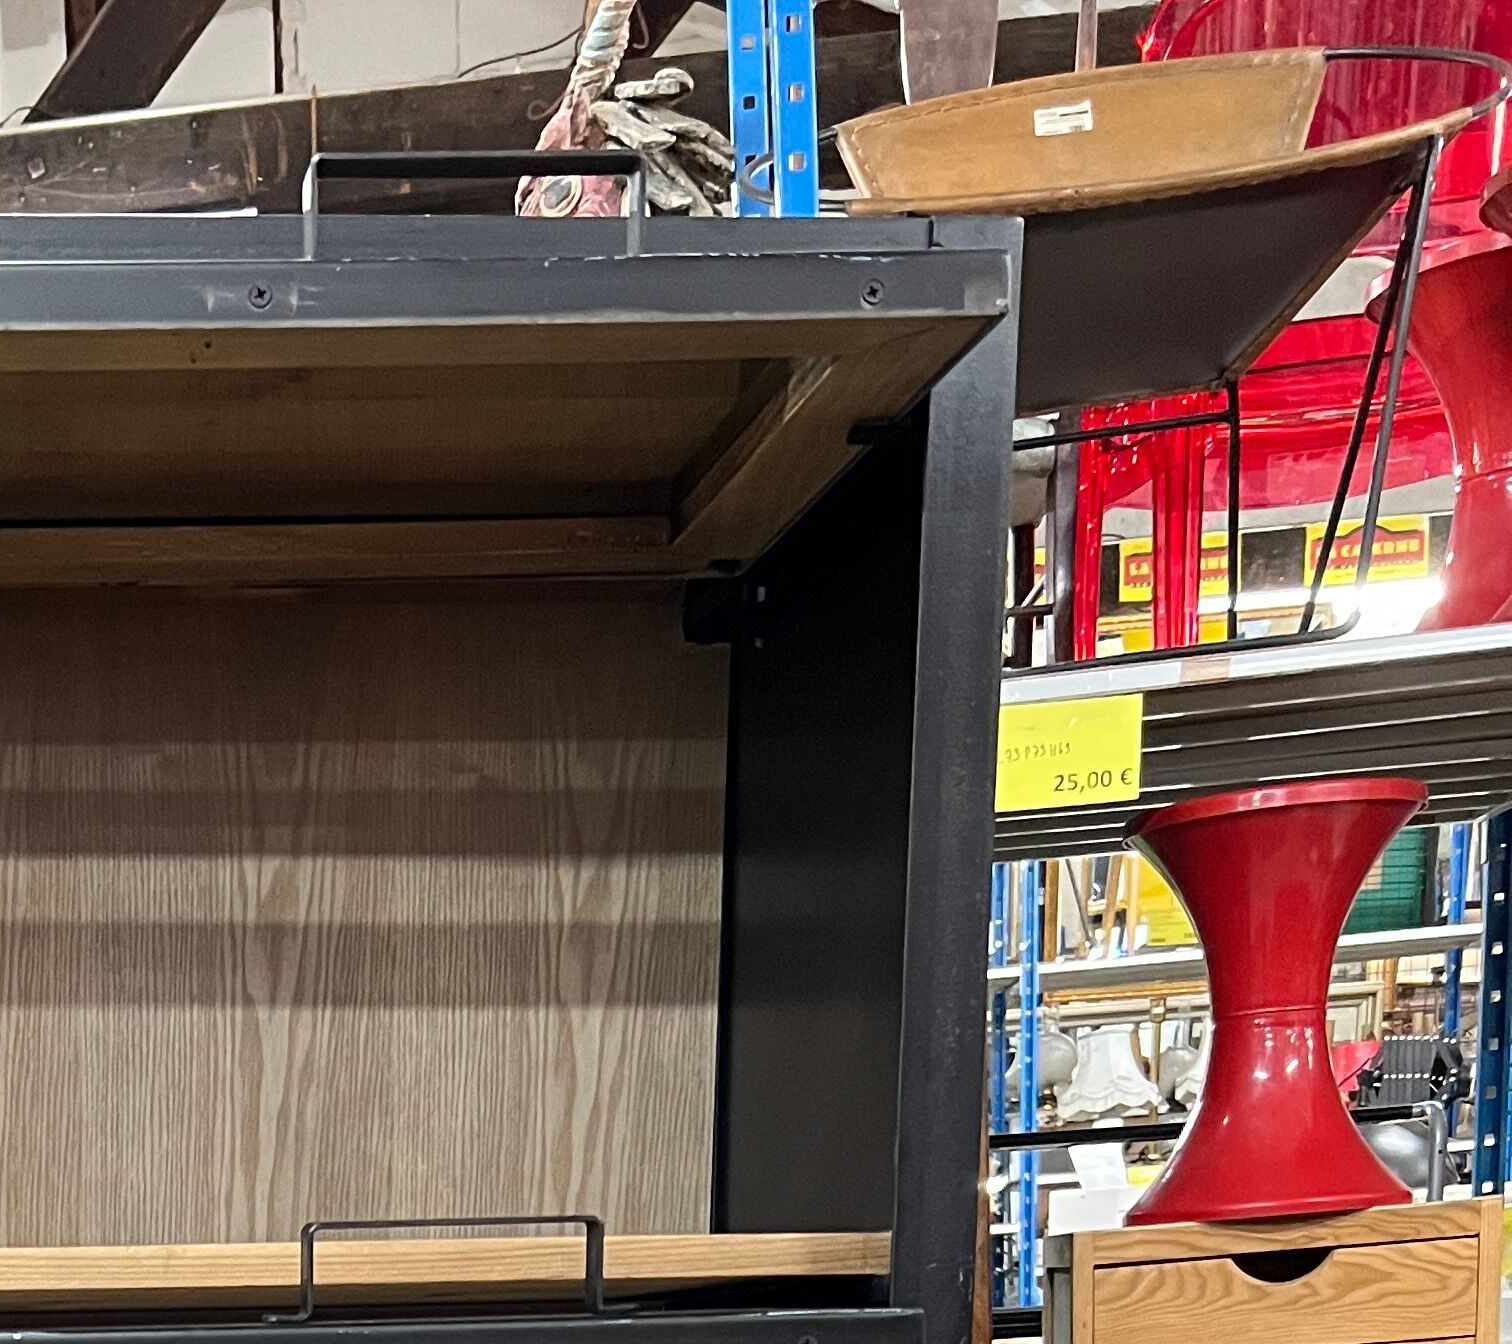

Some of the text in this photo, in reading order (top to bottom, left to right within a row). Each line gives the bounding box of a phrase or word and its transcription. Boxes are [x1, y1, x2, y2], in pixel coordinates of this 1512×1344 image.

[1340, 538, 1419, 558] CAERNE
[1053, 767, 1133, 794] 25,00 €
